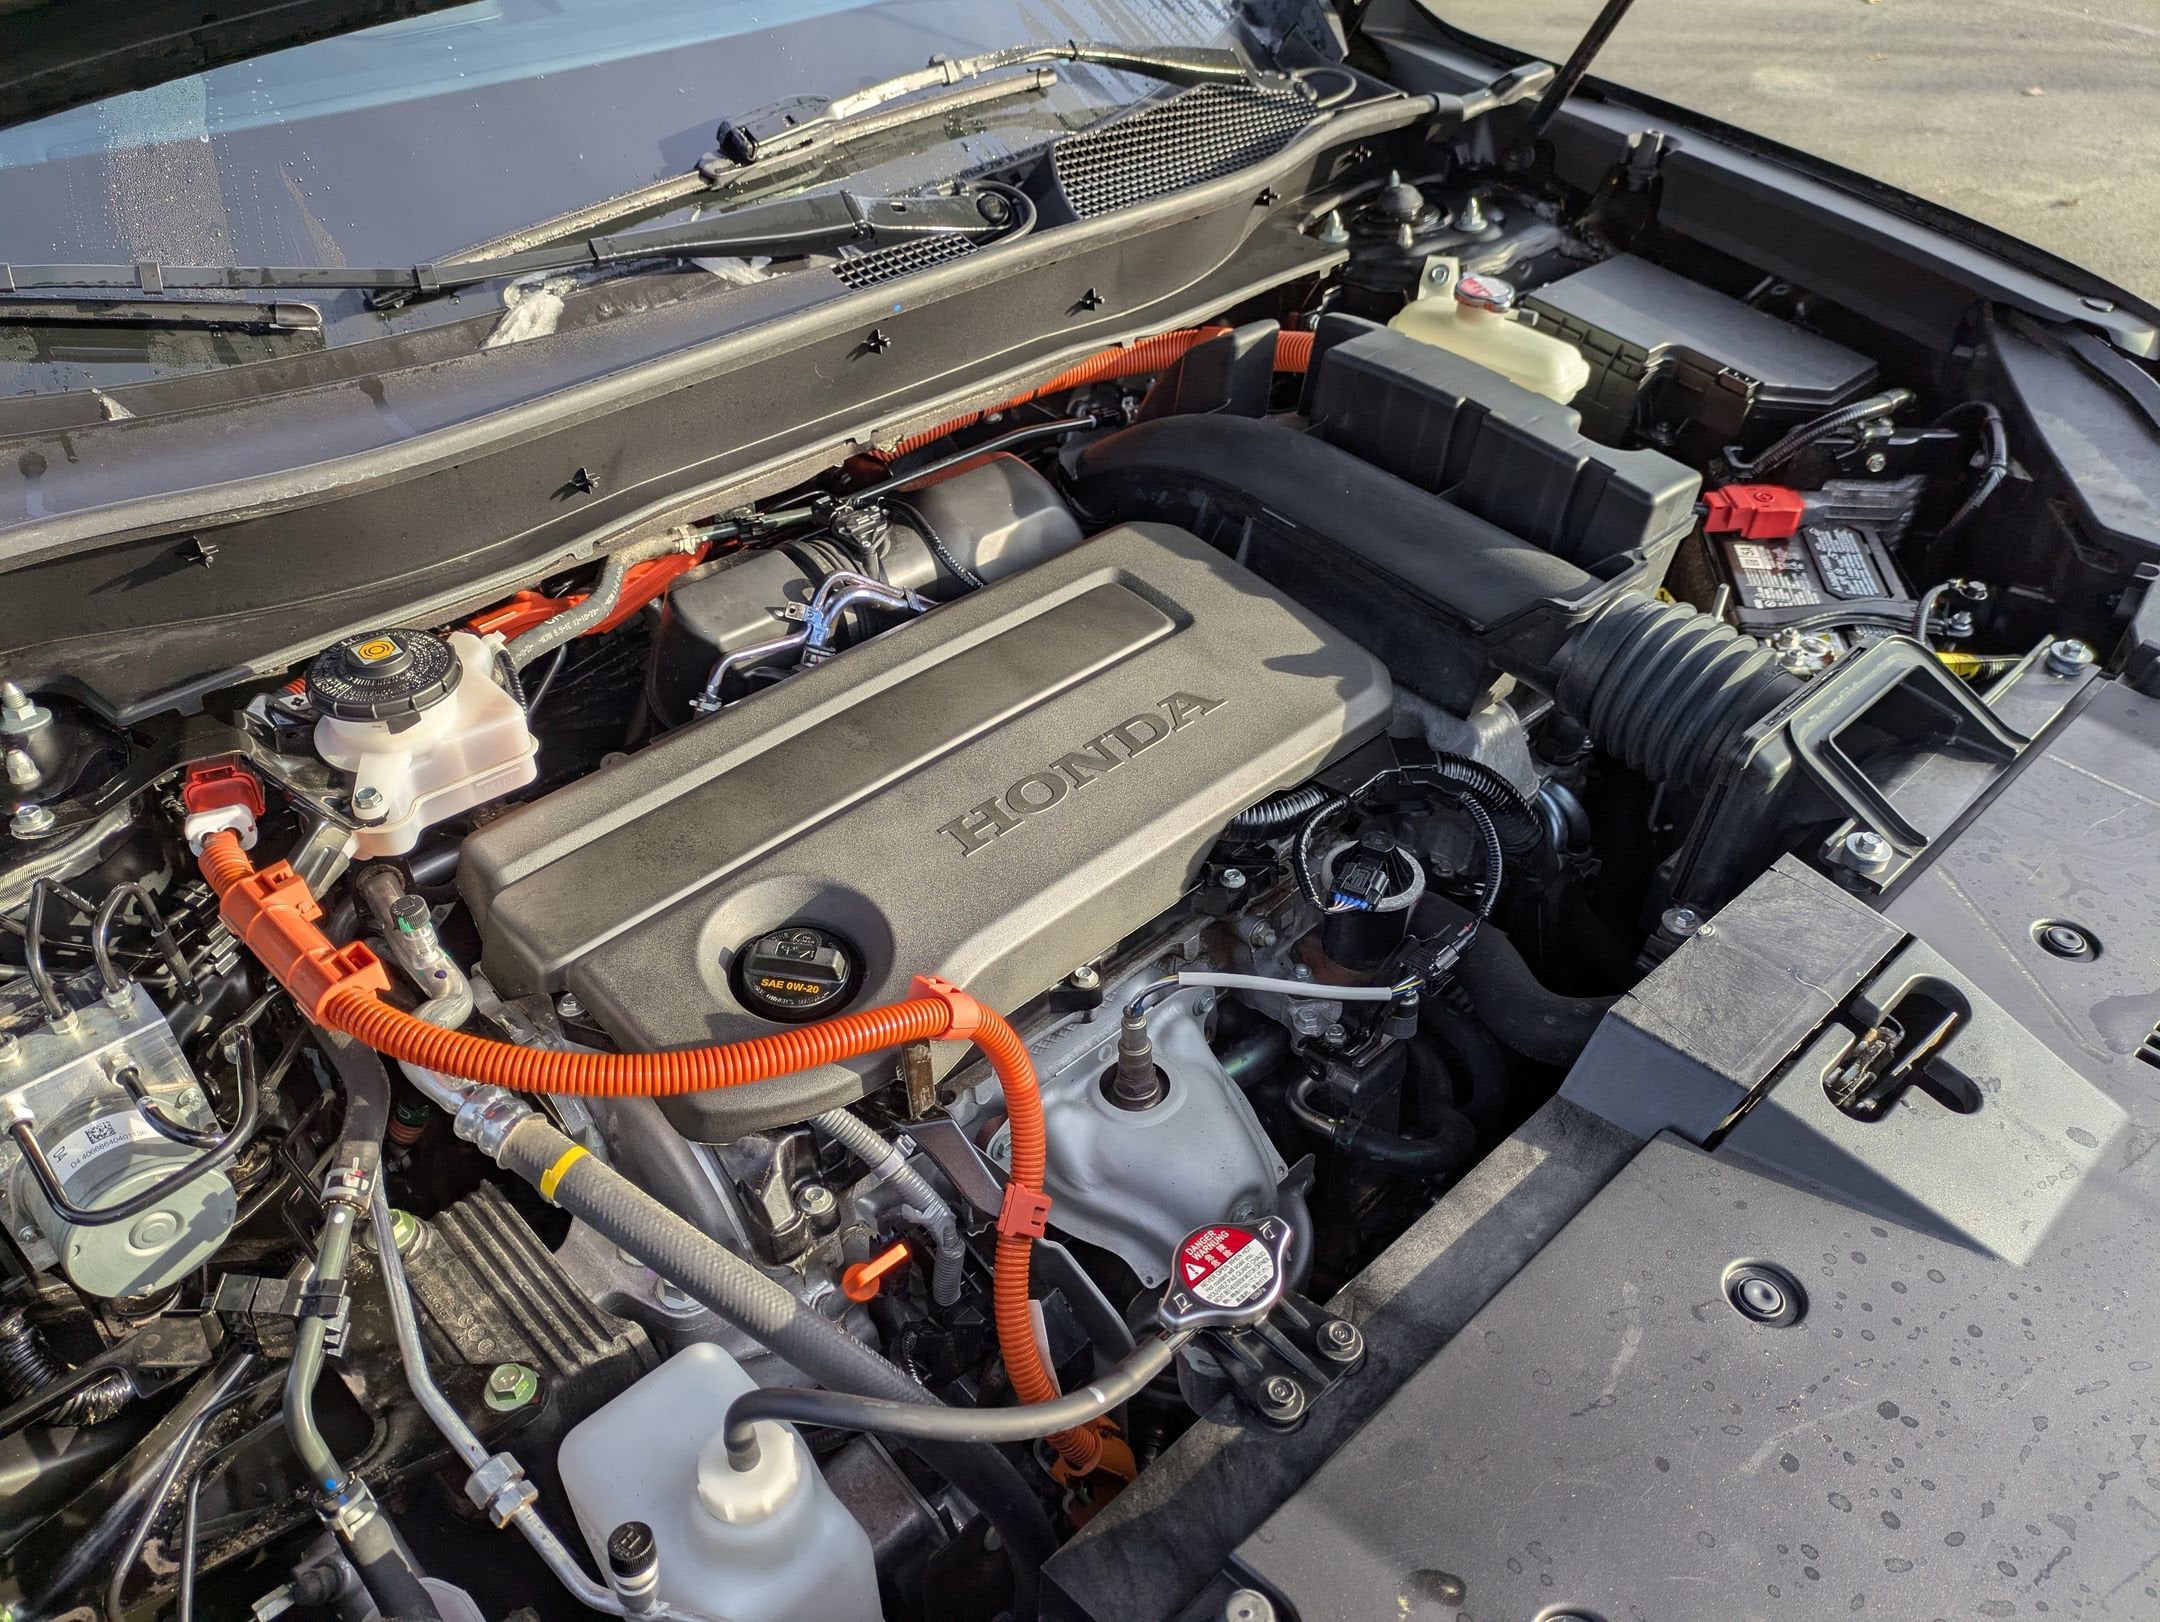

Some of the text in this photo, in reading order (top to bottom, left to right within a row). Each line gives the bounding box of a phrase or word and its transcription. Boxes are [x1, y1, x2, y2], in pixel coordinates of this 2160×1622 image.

[936, 690, 1229, 858] HONDA
[760, 978, 820, 995] SAE 0W-20
[1185, 1230, 1216, 1255] DANGER
[1192, 1230, 1229, 1261] WARNUNG
[1200, 1274, 1217, 1288] NEVER
[1216, 1264, 1230, 1276] OPEN
[1228, 1253, 1242, 1265] WHEN
